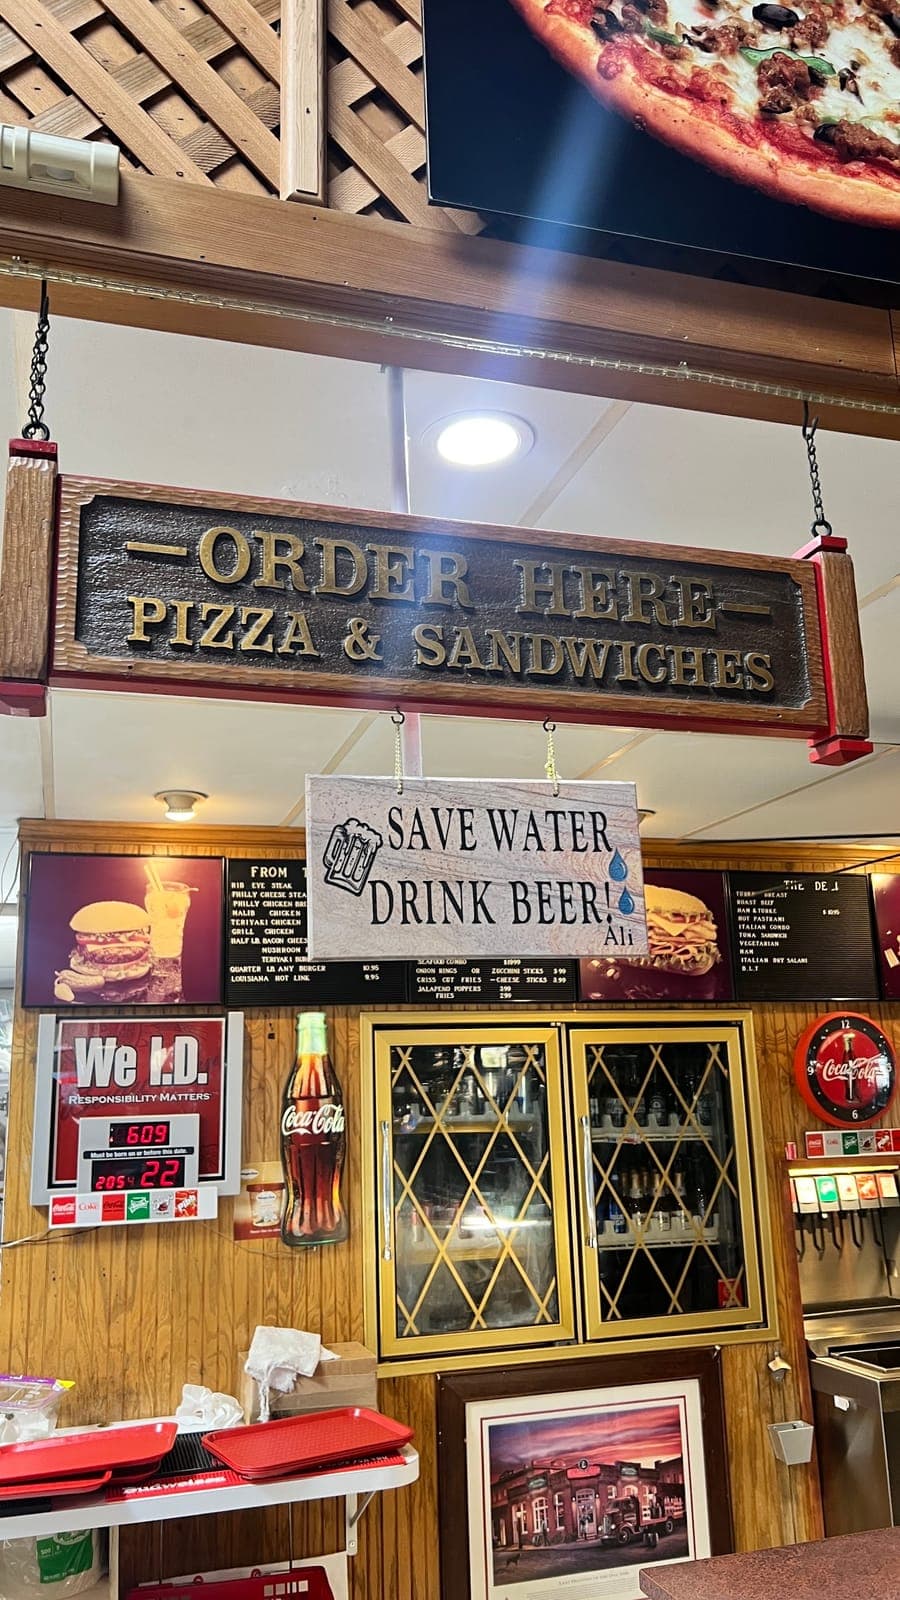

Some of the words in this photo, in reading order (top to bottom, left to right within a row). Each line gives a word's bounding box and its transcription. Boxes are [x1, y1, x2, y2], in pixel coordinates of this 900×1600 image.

[199, 526, 475, 613] ORDER
[513, 560, 717, 629] HERE
[127, 596, 321, 657] PIZZA
[344, 618, 384, 660] &
[412, 624, 776, 692] SANDWICHES
[388, 806, 478, 851] SAVE
[486, 808, 613, 852] WATER
[251, 866, 287, 878] FROM
[233, 900, 260, 908] PHILLY
[367, 880, 496, 925] DRINK
[508, 880, 613, 925] BEER!
[230, 937, 250, 945] HALF
[604, 925, 634, 946] Ali
[229, 965, 261, 973] QUARTER
[840, 1019, 851, 1029] 12
[75, 1036, 137, 1088] We
[150, 1035, 208, 1086] I.D.
[281, 1103, 345, 1137] Coca-Cola
[851, 1109, 859, 1119] 6
[127, 1125, 168, 1144] 609
